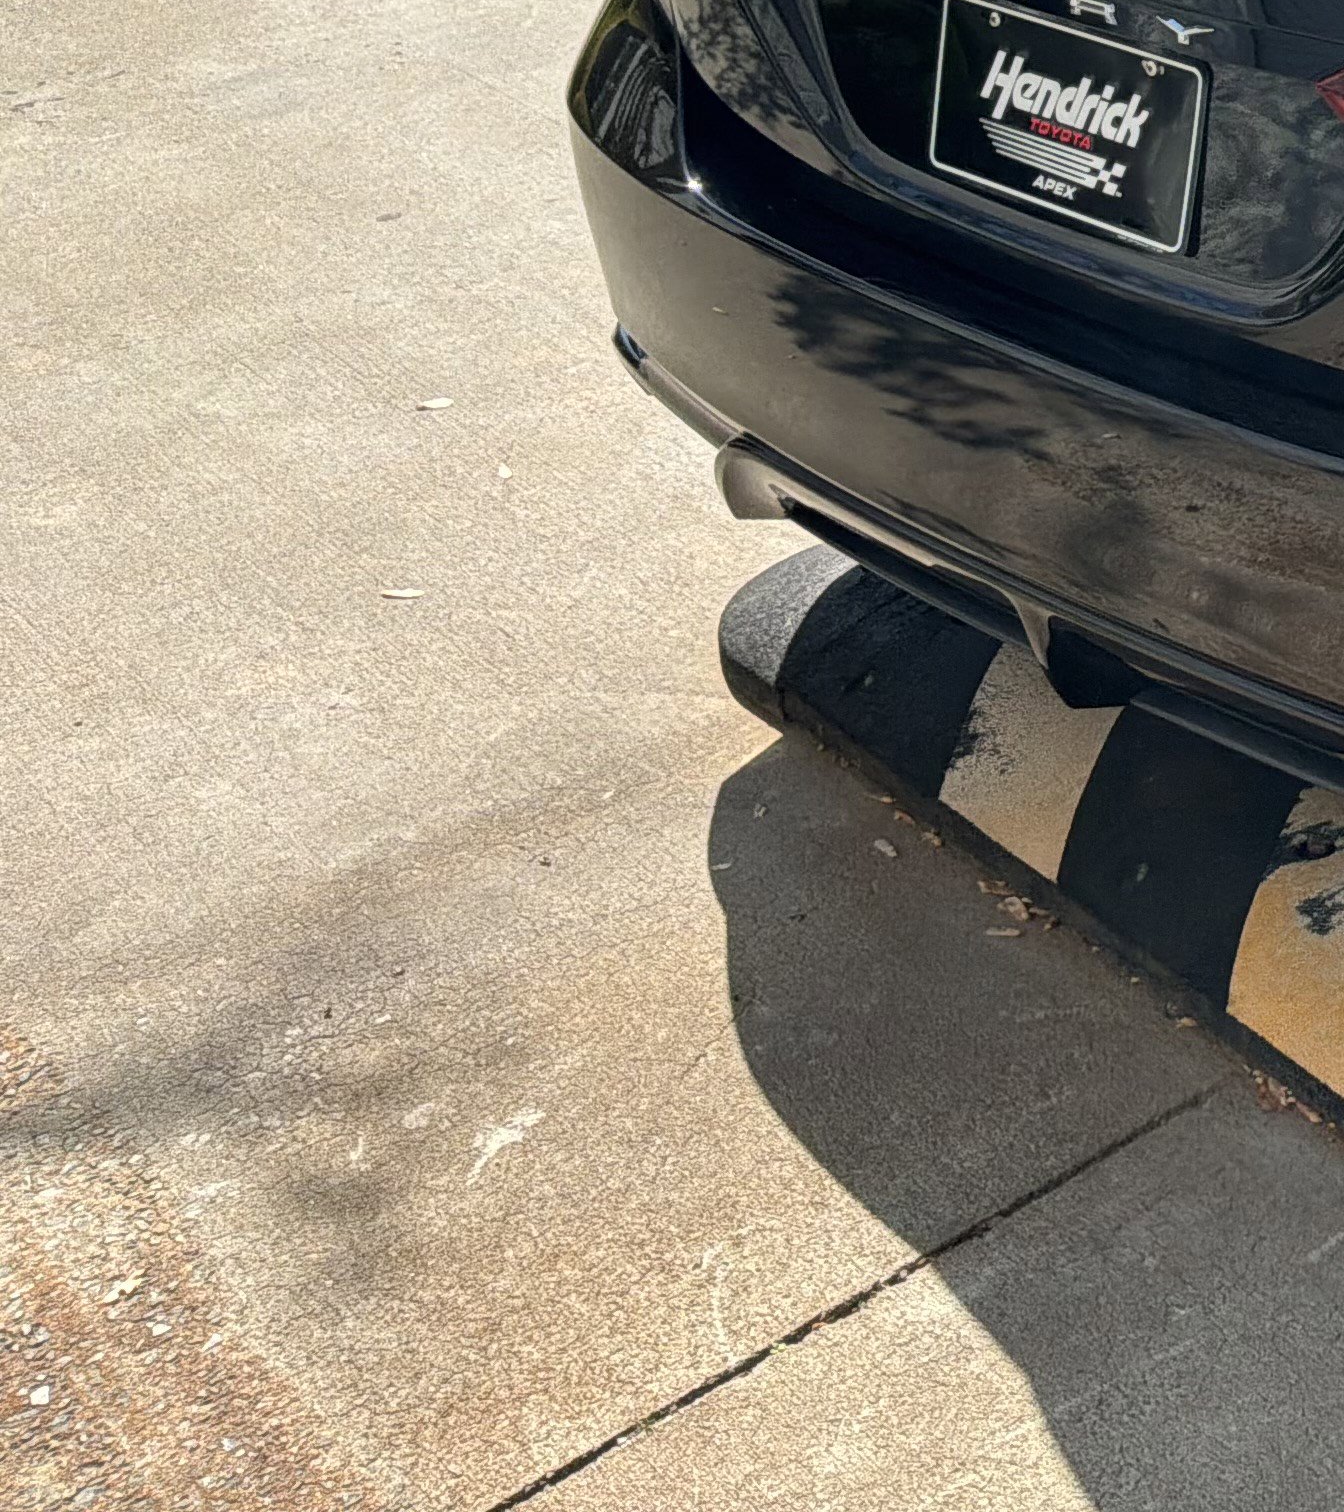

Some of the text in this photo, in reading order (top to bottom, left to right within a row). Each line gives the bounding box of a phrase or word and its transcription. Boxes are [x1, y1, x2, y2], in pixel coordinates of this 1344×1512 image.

[980, 50, 1150, 148] Hendrick
[1029, 117, 1093, 151] TOYOTA
[1031, 174, 1077, 201] APEX
